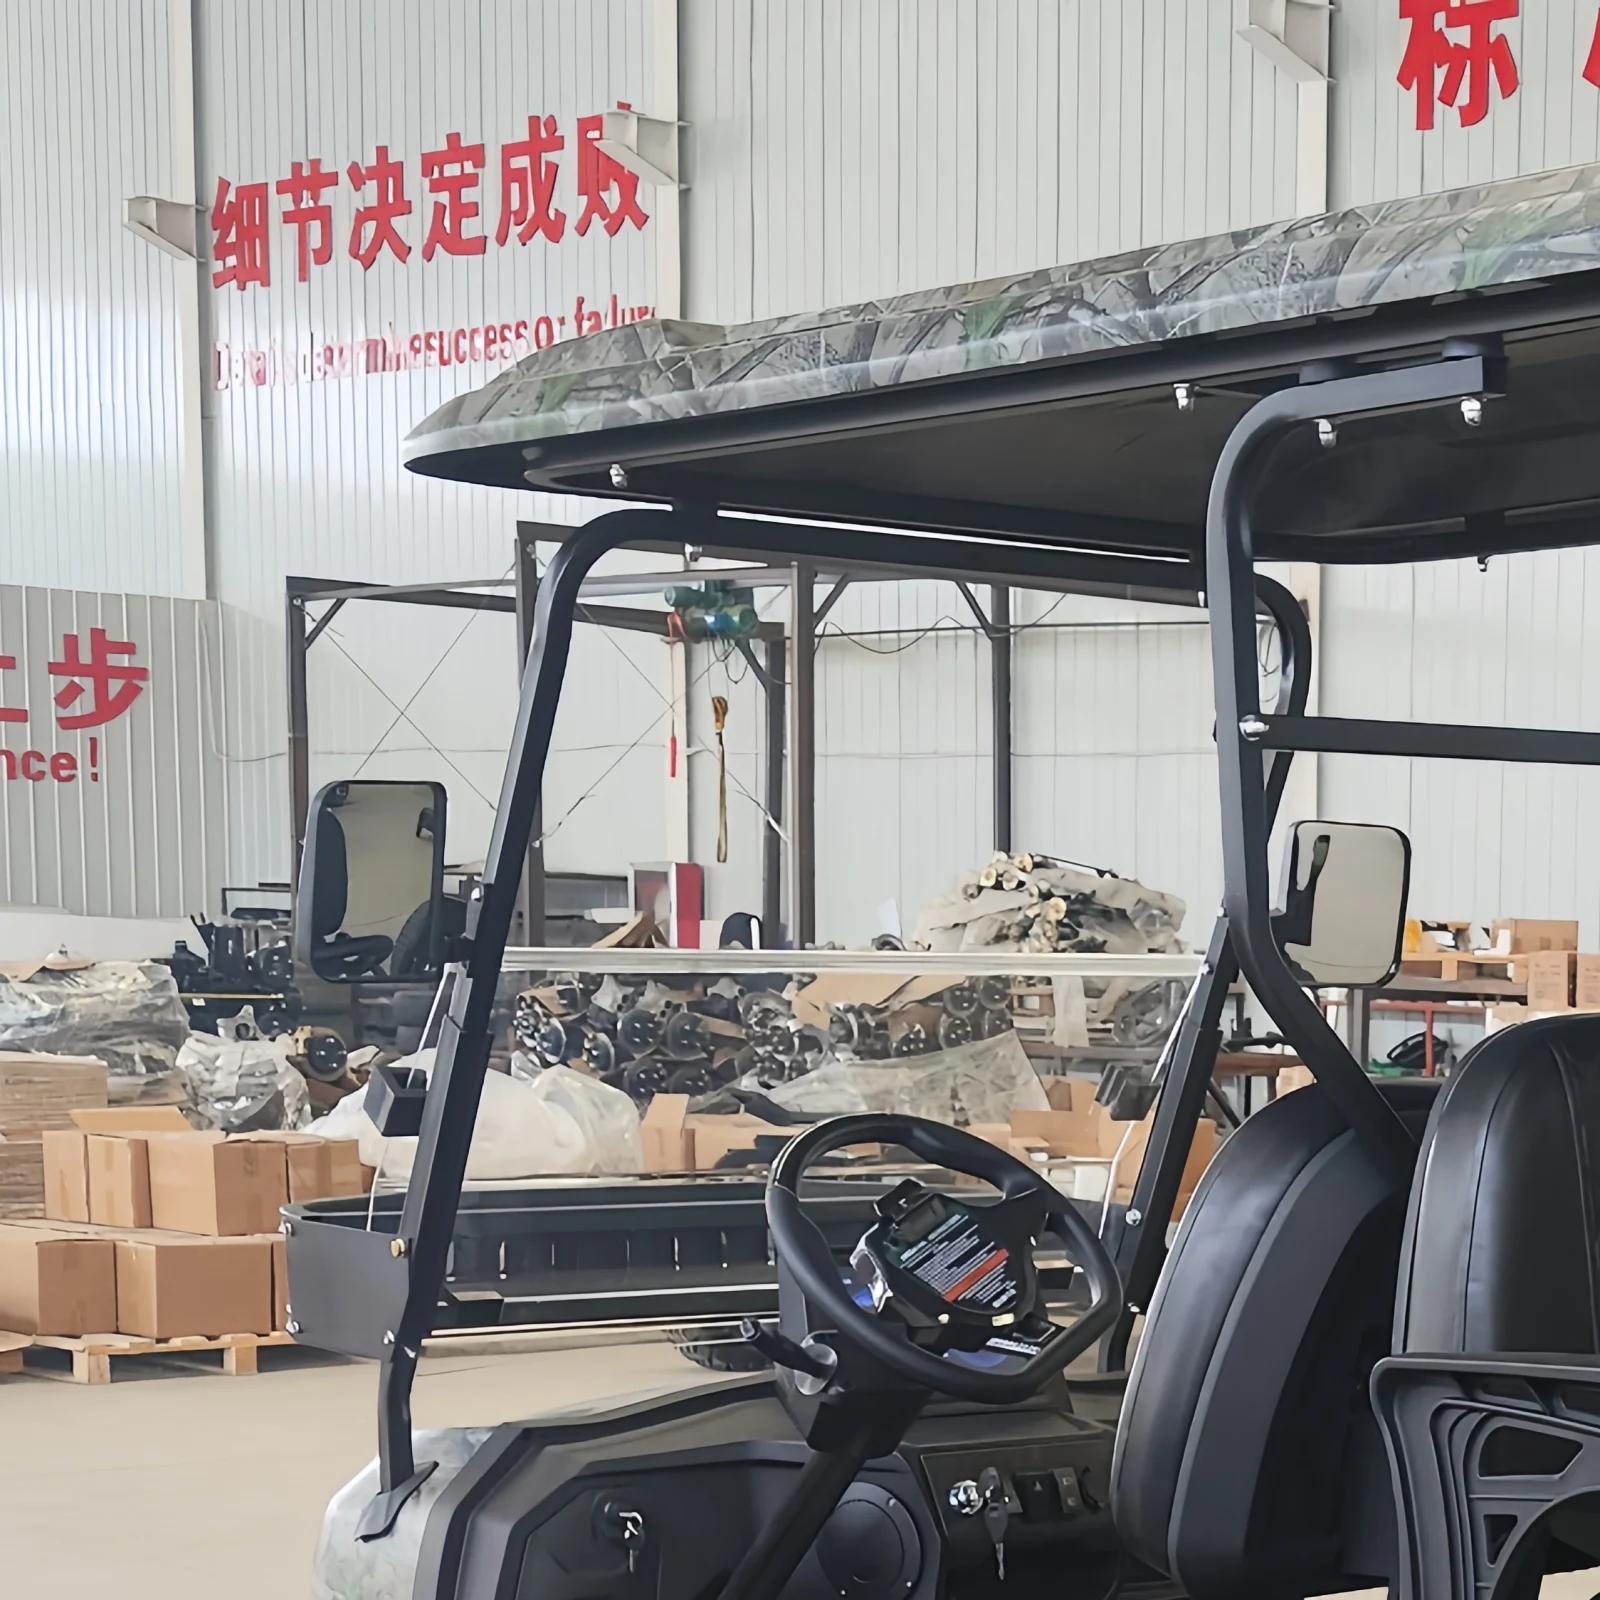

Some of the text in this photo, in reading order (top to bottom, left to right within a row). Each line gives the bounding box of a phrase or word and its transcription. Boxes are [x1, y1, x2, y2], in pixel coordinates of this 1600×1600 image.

[210, 101, 648, 292] 细节决定成败
[423, 319, 530, 368] success
[0, 627, 149, 730] 步
